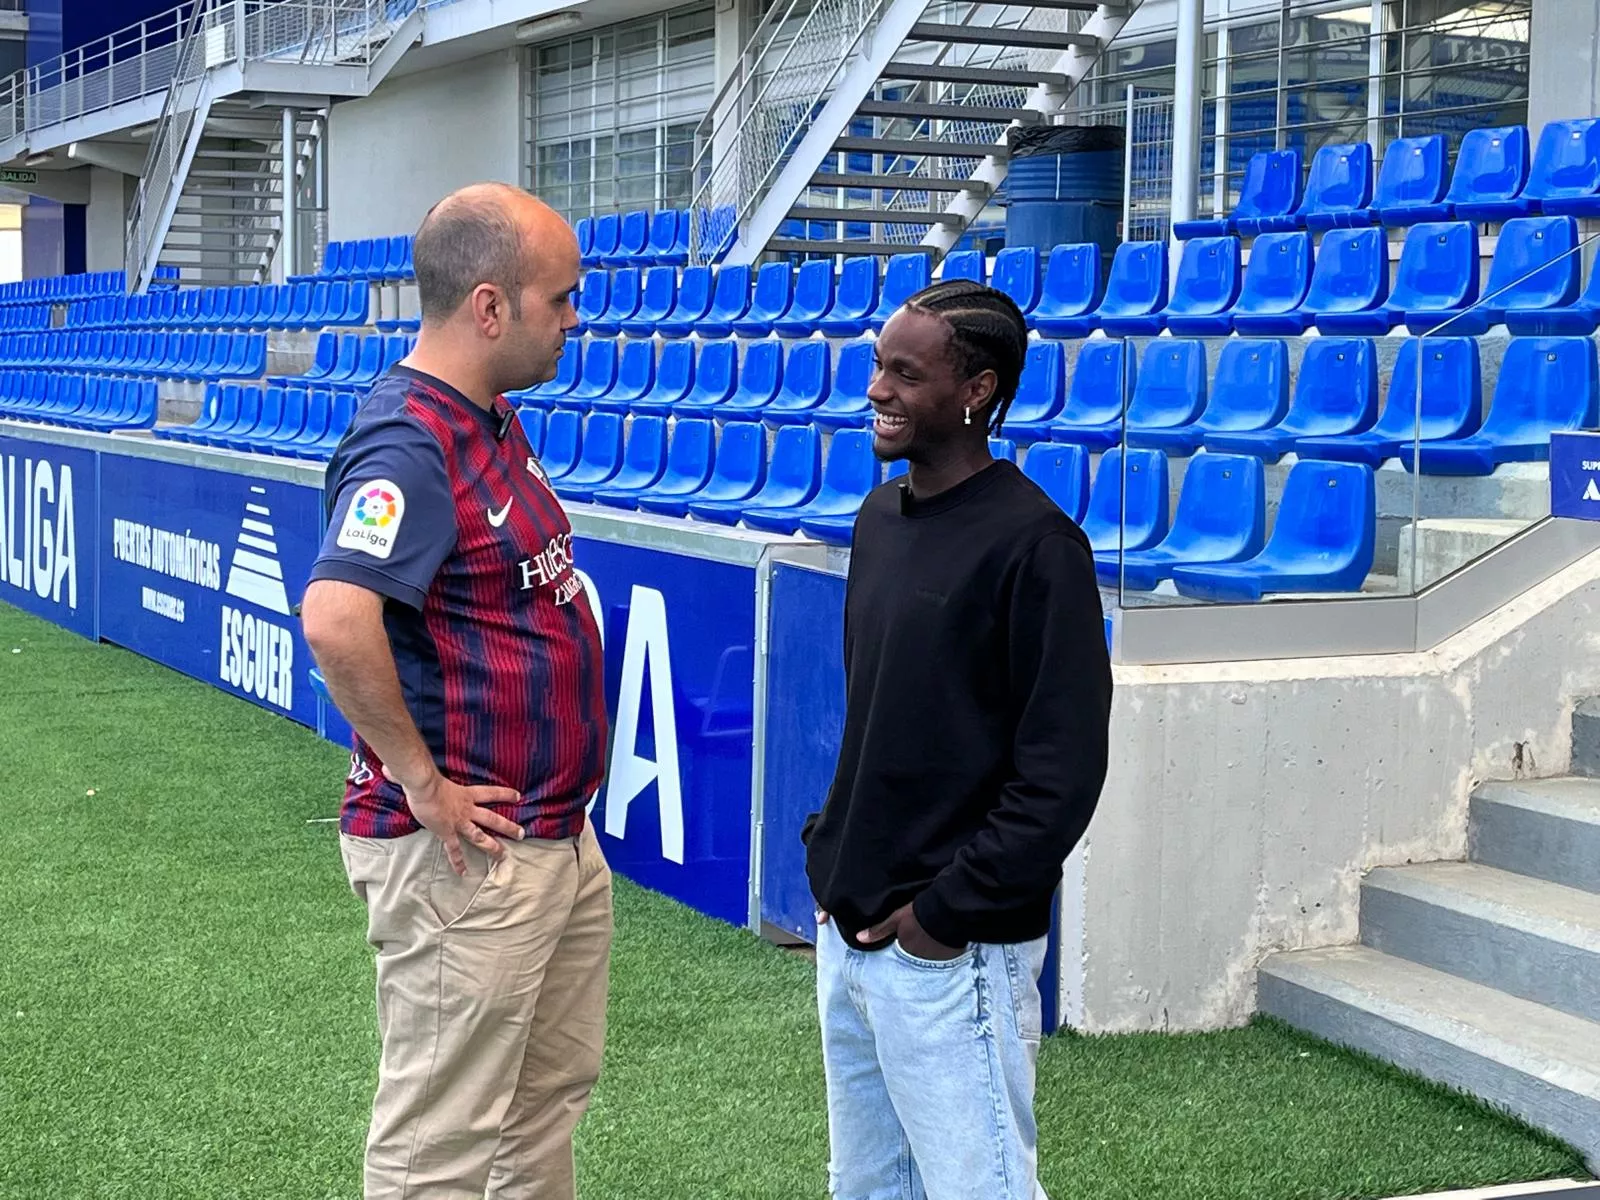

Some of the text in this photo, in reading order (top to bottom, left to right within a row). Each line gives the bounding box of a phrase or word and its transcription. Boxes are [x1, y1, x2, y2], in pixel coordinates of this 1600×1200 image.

[0, 171, 35, 182] SALIDA
[113, 518, 151, 569] PUERTAS
[345, 528, 388, 547] LaLiga
[220, 605, 293, 711] ESCUER
